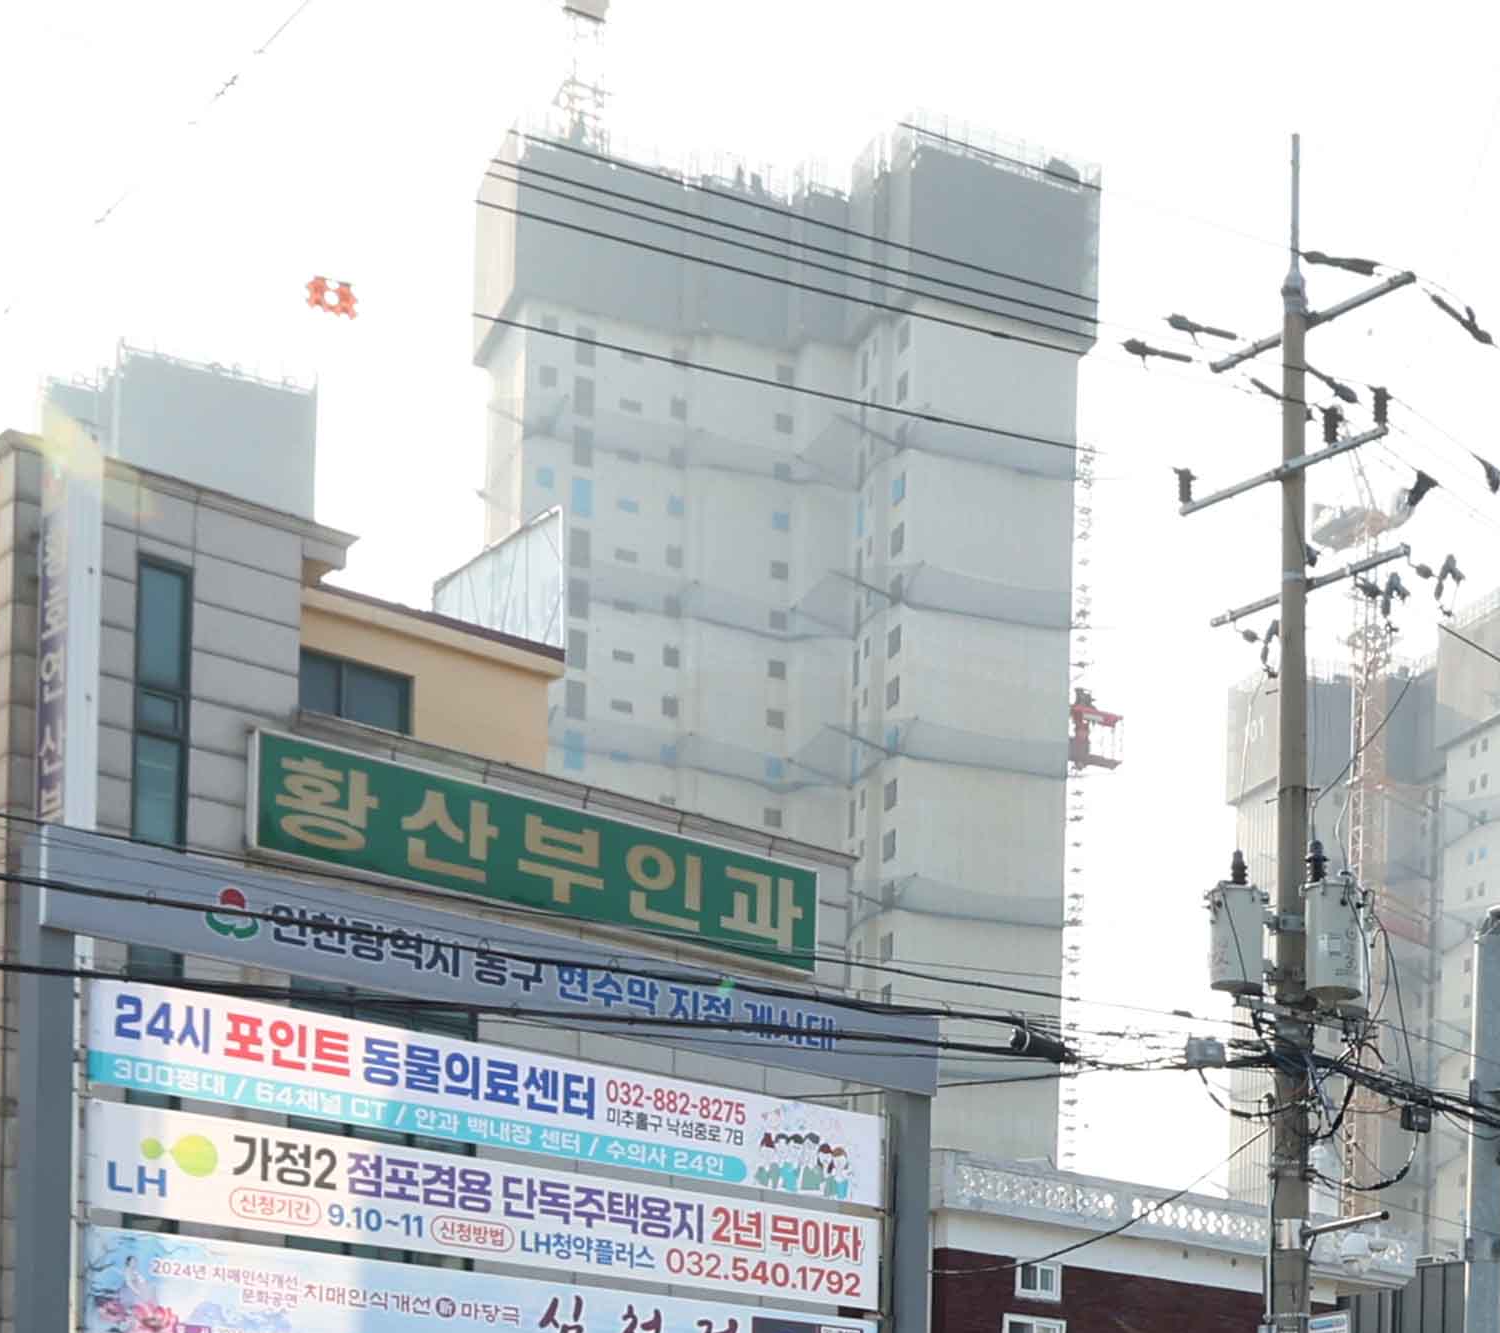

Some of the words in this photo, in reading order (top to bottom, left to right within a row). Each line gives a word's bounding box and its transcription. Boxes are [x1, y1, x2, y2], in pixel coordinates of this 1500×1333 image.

[275, 755, 804, 952] 황산부인과
[272, 903, 461, 978] 인천광역시
[475, 950, 544, 991] 동구
[557, 962, 658, 1018] 현수막
[670, 983, 731, 1029] 지정
[115, 994, 210, 1054] 24시
[224, 1012, 350, 1077] 포인트
[363, 1037, 595, 1120] 동물의료센터
[606, 1080, 746, 1126] 032-882-8275
[107, 1161, 166, 1196] LH
[232, 1135, 337, 1190] 가정2
[347, 1152, 492, 1213] 점포겸용
[502, 1176, 704, 1243] 단독주택용지
[711, 1207, 763, 1249] 2년
[770, 1214, 863, 1262] 무이자
[541, 1129, 581, 1152] 센터
[607, 1138, 667, 1167] 수의사
[674, 1150, 724, 1177] 24인
[239, 1194, 311, 1219] 신청기간
[328, 1204, 423, 1238] 9.10~11
[440, 1222, 505, 1248] 신청방법
[520, 1230, 655, 1270] LH청약플러스
[666, 1248, 861, 1297] 032.540.1792
[303, 1284, 431, 1316] 치매인식개선
[461, 1303, 521, 1327] 마당극
